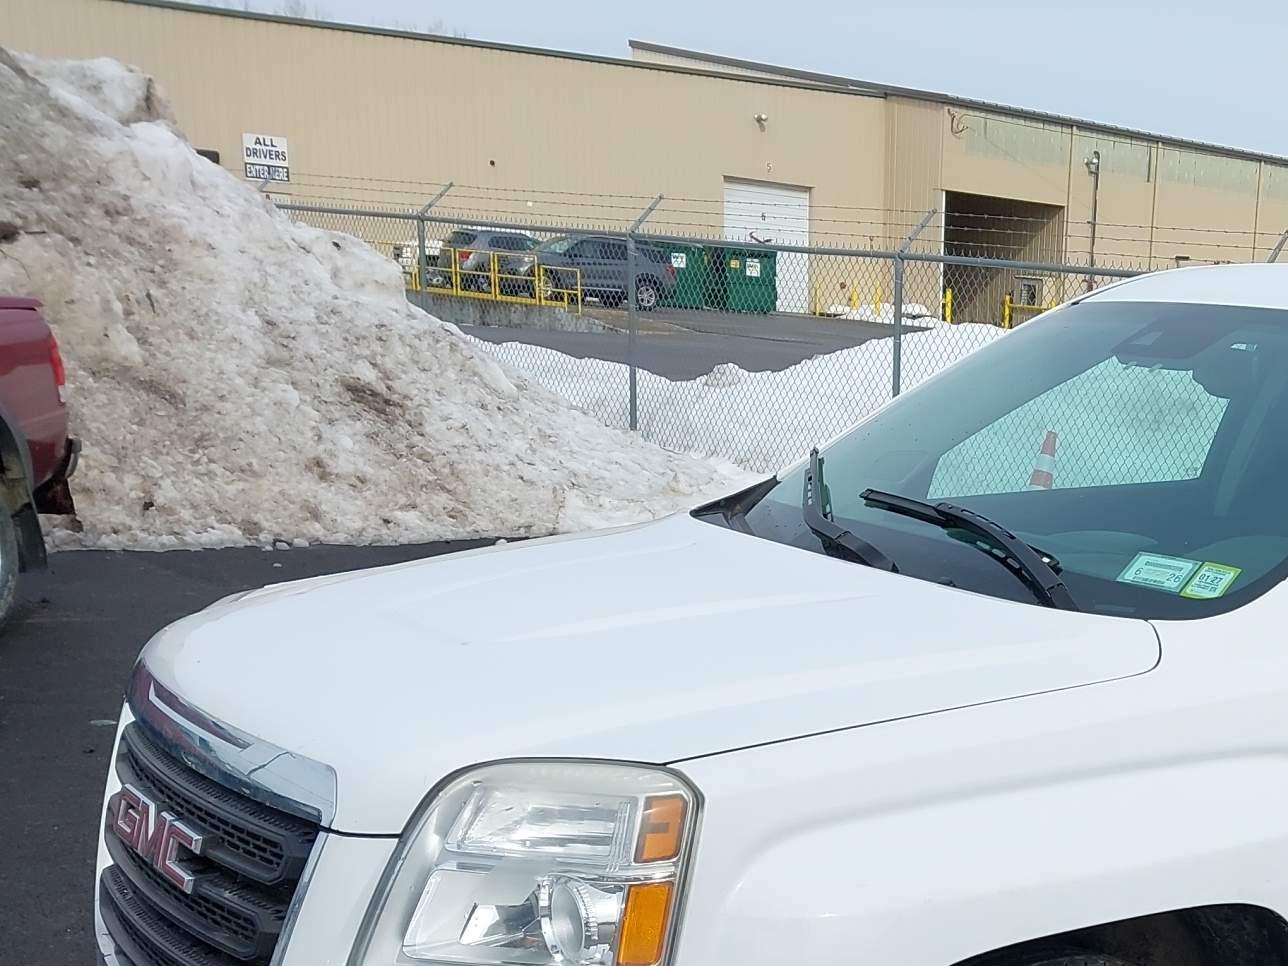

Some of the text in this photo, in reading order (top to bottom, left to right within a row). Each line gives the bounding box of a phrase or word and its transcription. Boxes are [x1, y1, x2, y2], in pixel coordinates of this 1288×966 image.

[254, 136, 278, 148] ALL
[245, 146, 287, 162] DRIVERS
[247, 164, 269, 179] ENTER
[1166, 573, 1183, 584] 26
[109, 783, 203, 895] GMC
